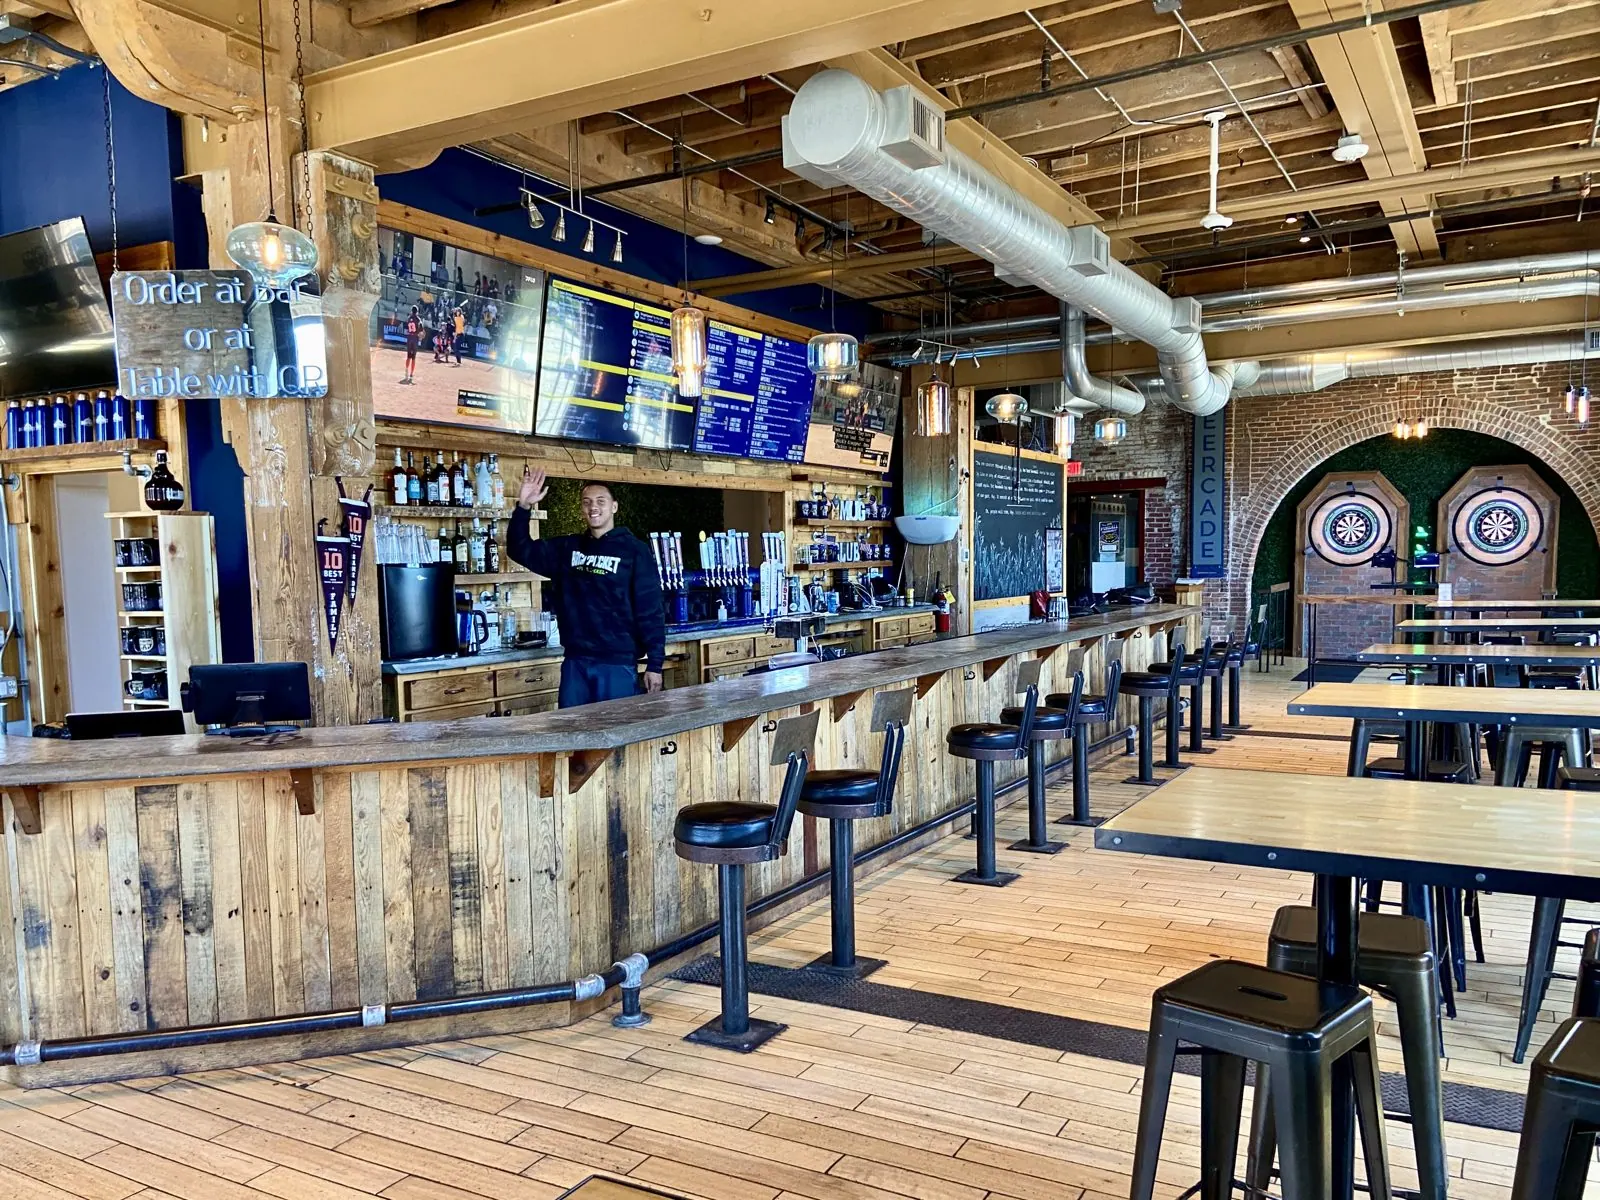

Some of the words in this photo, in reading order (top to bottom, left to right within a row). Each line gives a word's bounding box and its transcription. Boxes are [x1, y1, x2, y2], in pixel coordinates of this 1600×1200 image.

[123, 273, 208, 305] Order
[215, 276, 245, 304] at
[183, 327, 217, 351] or
[223, 323, 255, 351] at
[122, 365, 200, 396] Table
[206, 365, 266, 397] with
[279, 365, 325, 396] QR
[840, 500, 866, 521] MUG
[348, 515, 363, 534] 10
[323, 552, 343, 570] 10
[323, 569, 343, 578] BEST
[329, 592, 338, 639] FAMILY
